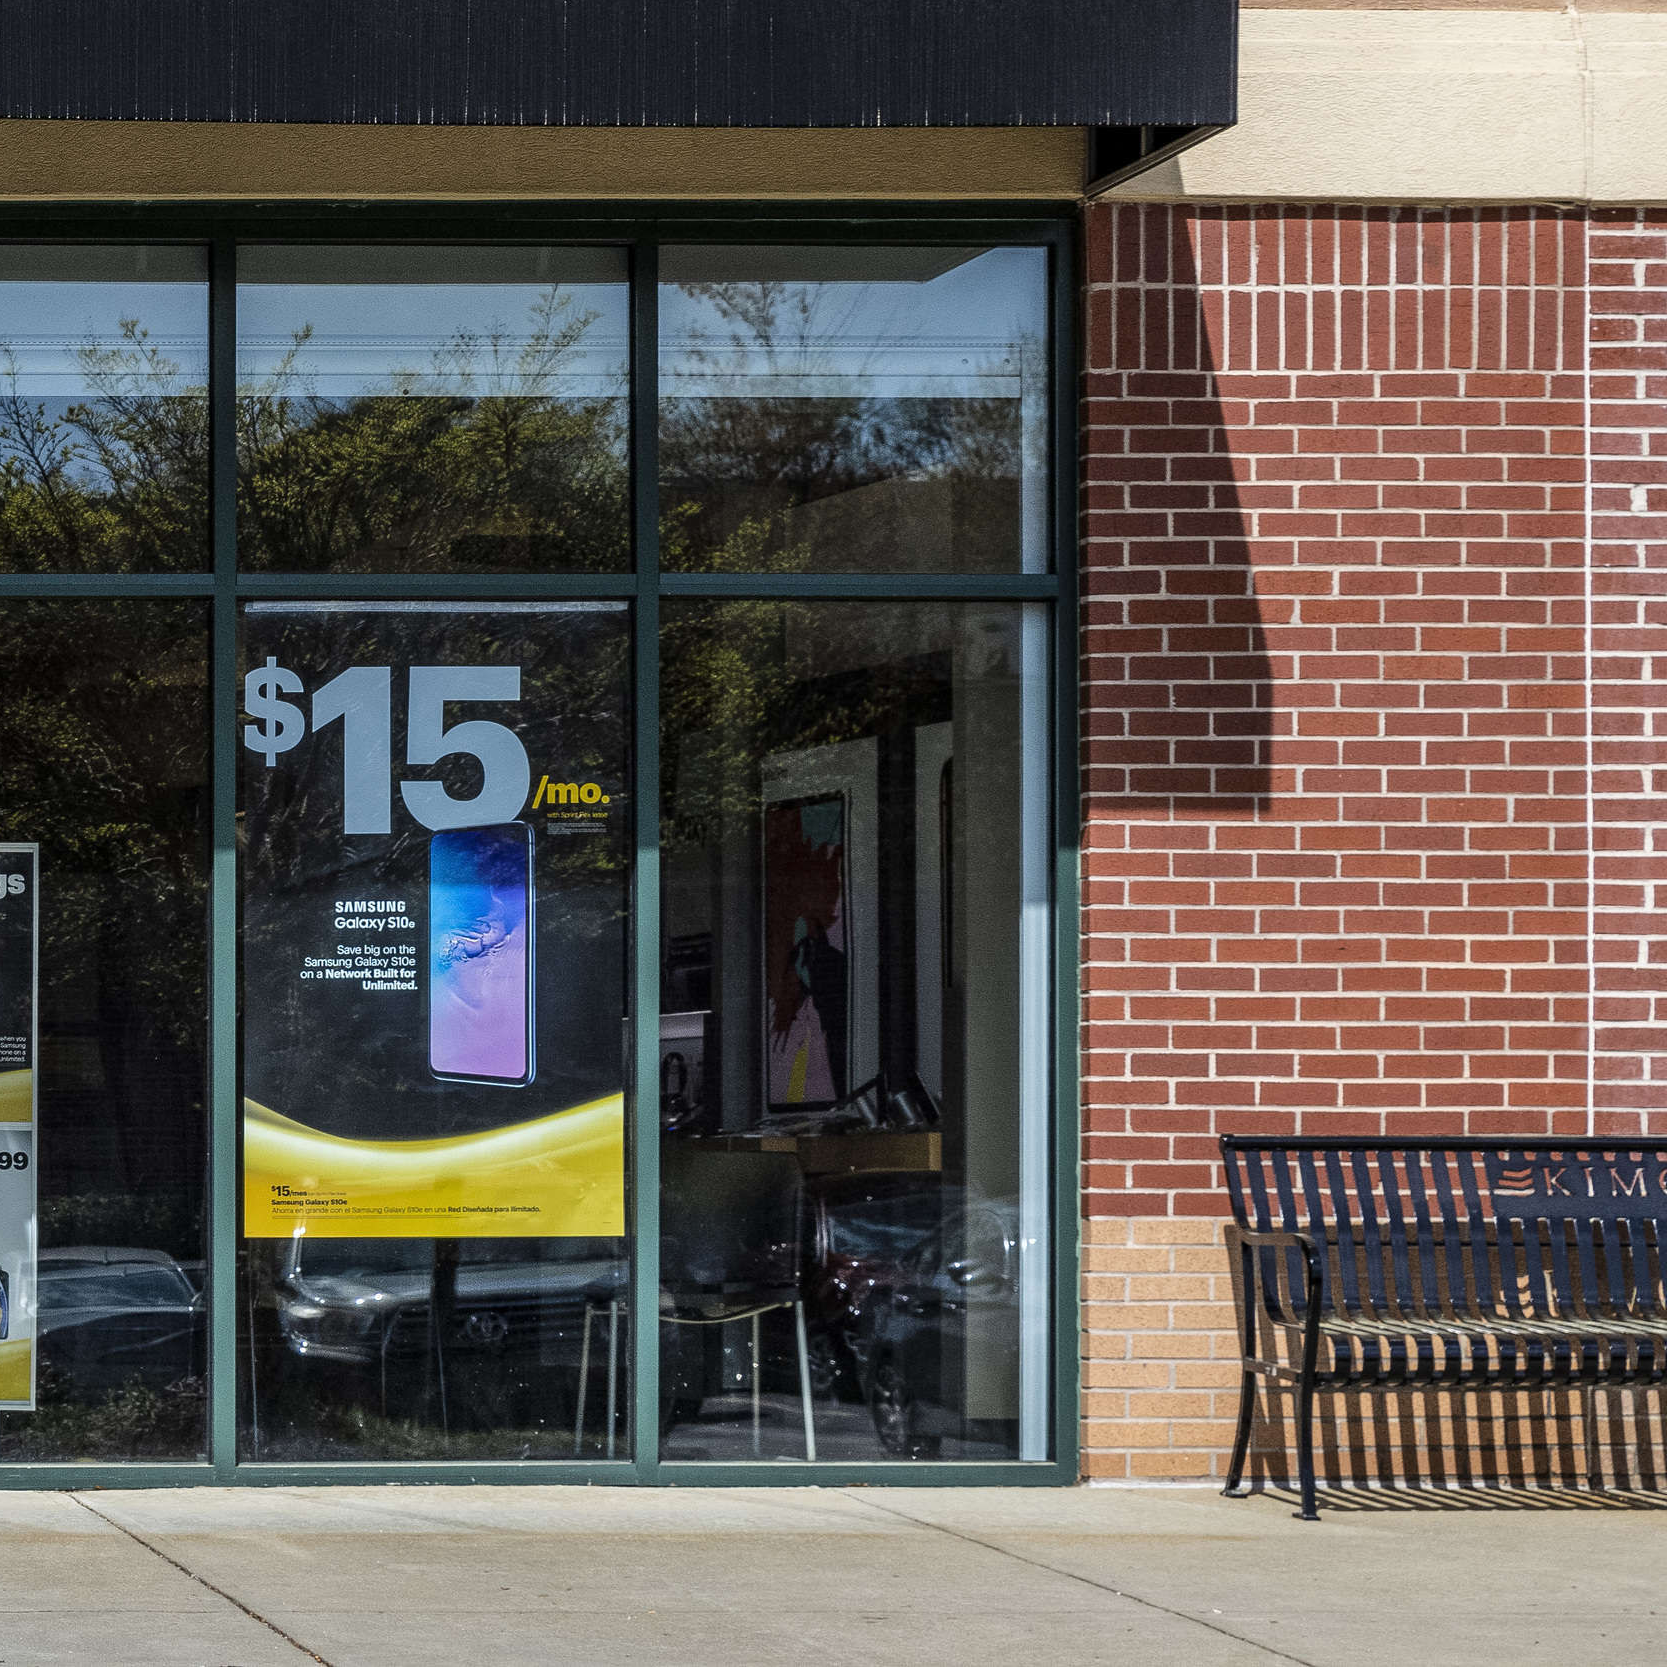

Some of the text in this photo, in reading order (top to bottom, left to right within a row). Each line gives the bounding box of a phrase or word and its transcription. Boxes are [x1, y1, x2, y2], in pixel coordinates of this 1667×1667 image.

[334, 900, 406, 913] SAMSUNG
[334, 916, 416, 932] Galaxy S10e
[336, 944, 416, 957] Save big on the
[304, 956, 416, 969] Samsung Galaxy S10e
[299, 968, 417, 979] on a Network Built for
[362, 980, 418, 991] Unlimited.
[305, 1198, 330, 1206] Galaxy
[352, 1207, 383, 1215] Samsung
